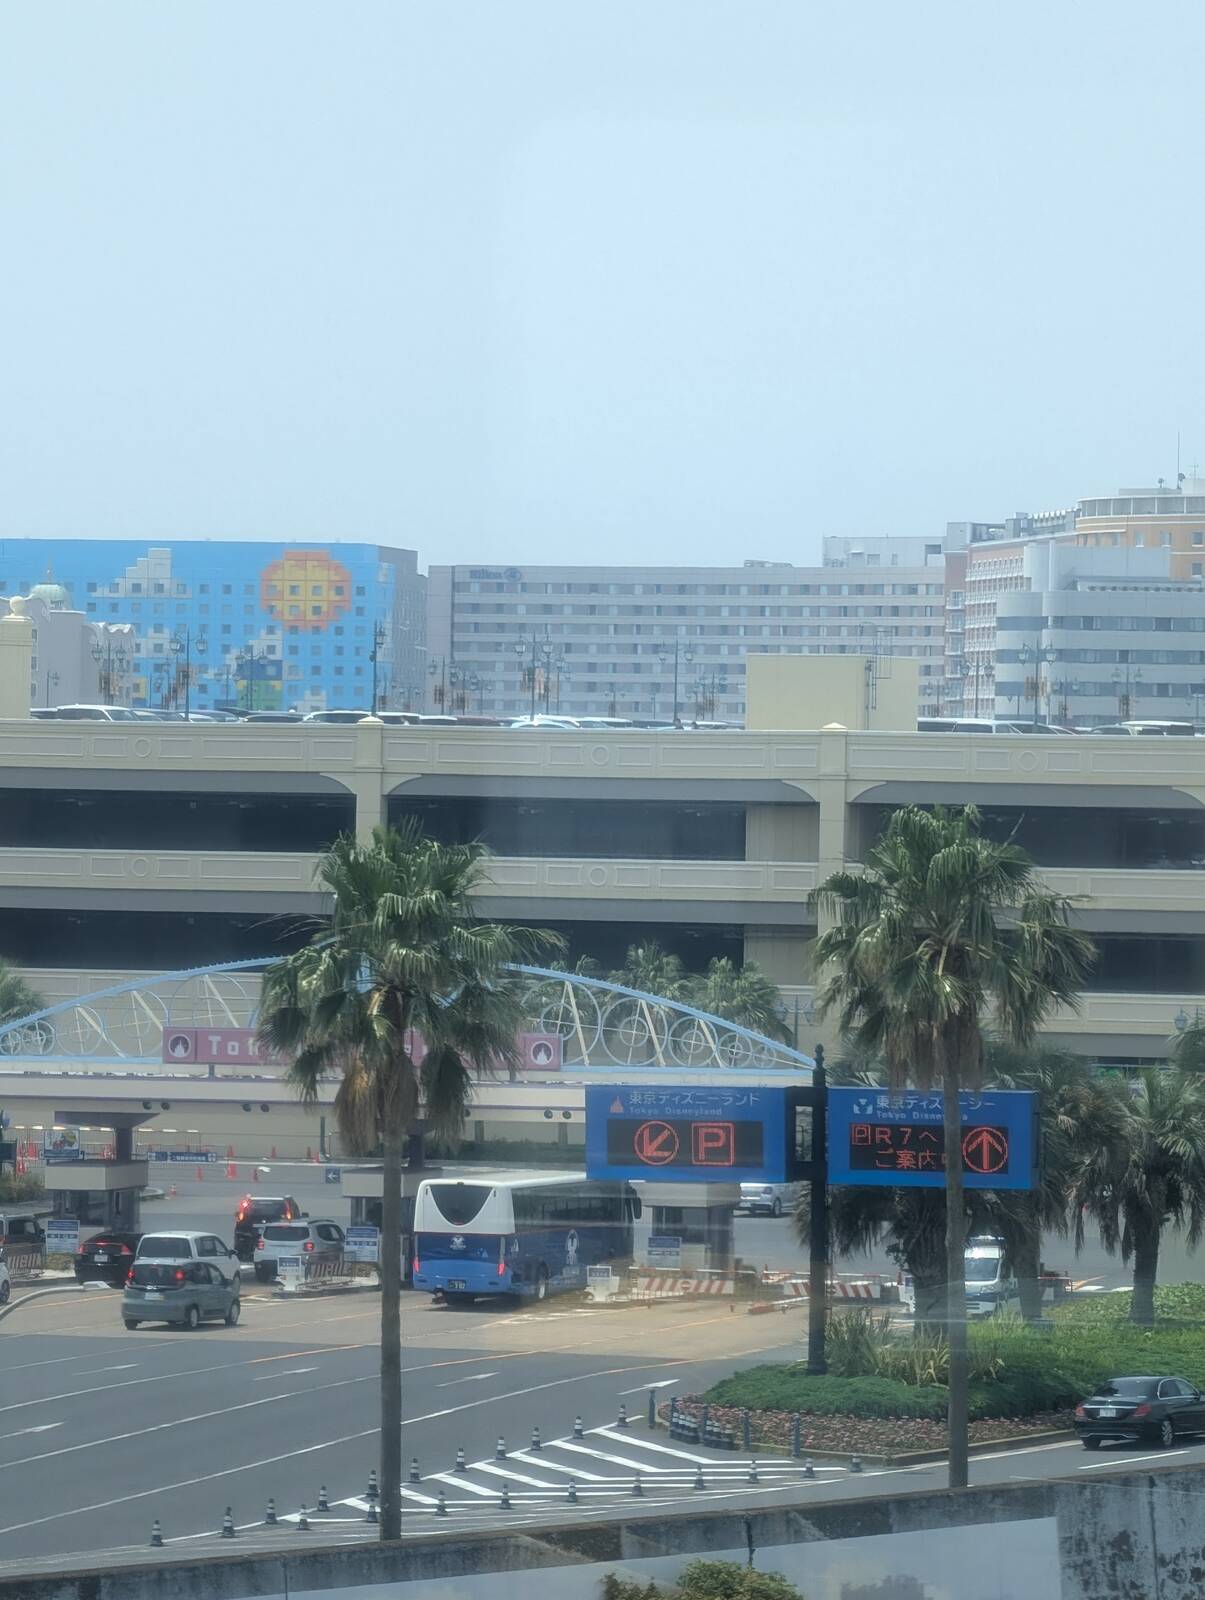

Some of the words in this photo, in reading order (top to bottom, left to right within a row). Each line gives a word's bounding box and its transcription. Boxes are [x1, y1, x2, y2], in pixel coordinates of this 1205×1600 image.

[629, 1090, 760, 1107] 東京ディズニーランド
[876, 1095, 996, 1110] 東京ディズーシー
[629, 1107, 658, 1116] Tokyo
[665, 1107, 723, 1117] Disneyland
[876, 1110, 906, 1121] Tokyo
[696, 1126, 728, 1161] P
